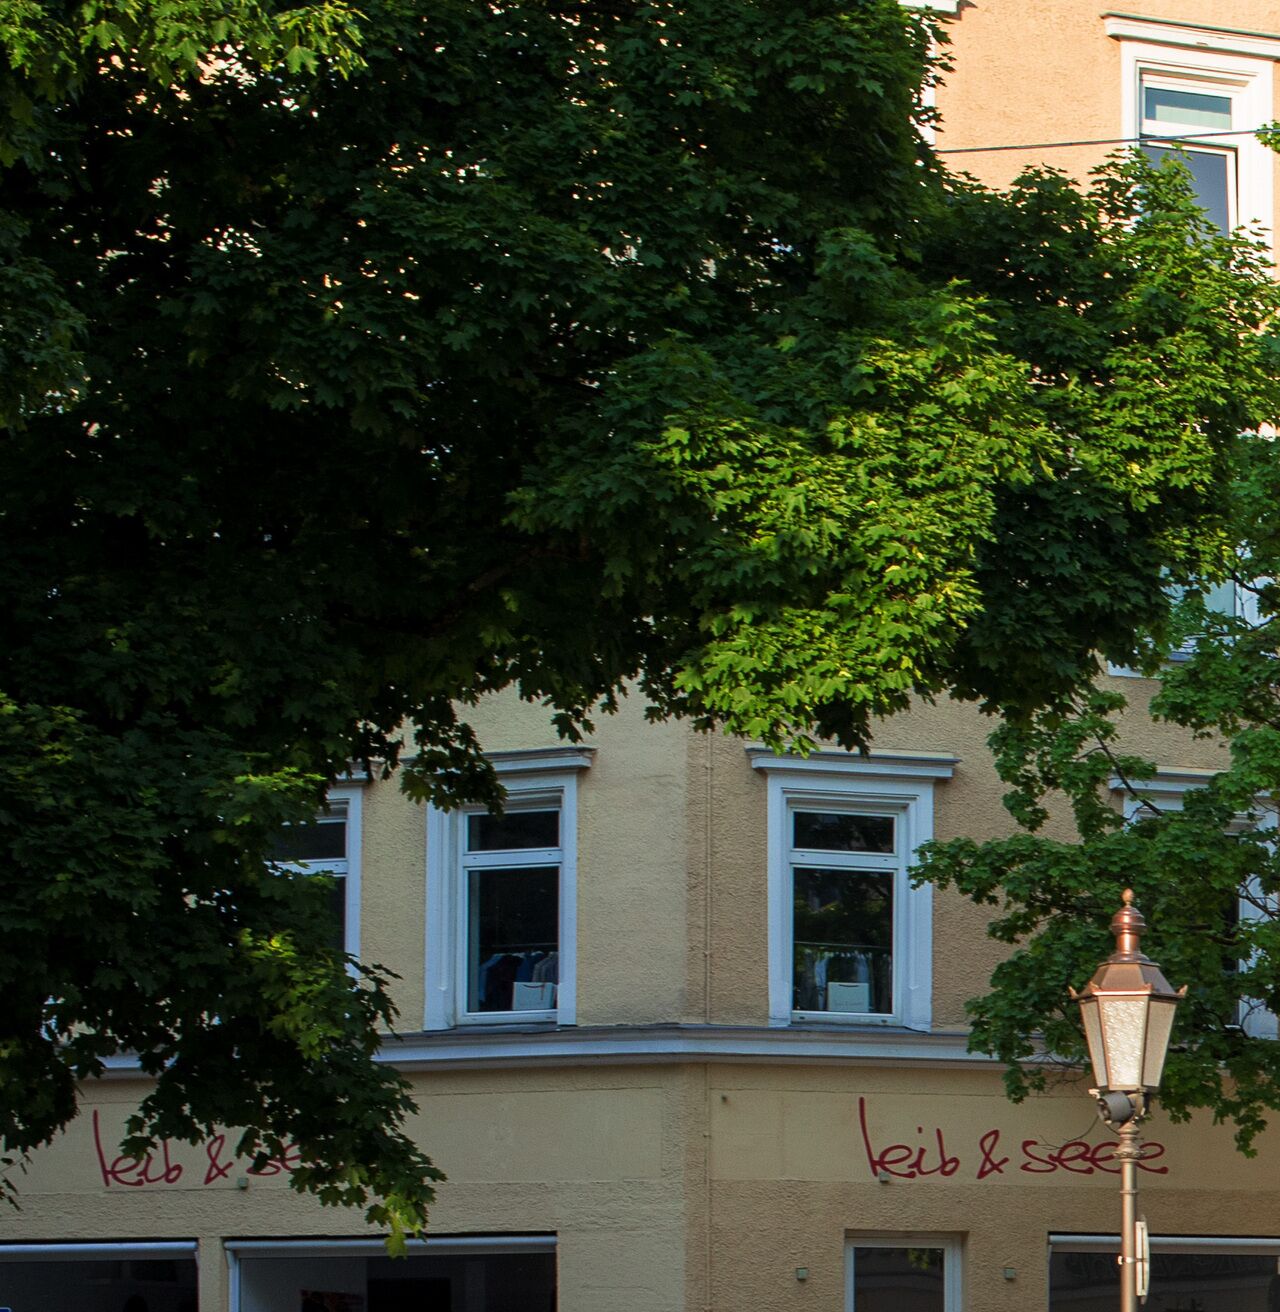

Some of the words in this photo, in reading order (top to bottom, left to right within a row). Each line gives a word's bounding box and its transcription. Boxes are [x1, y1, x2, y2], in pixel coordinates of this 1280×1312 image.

[204, 1134, 233, 1186] &
[859, 1096, 959, 1179] leib
[977, 1129, 1009, 1180] &
